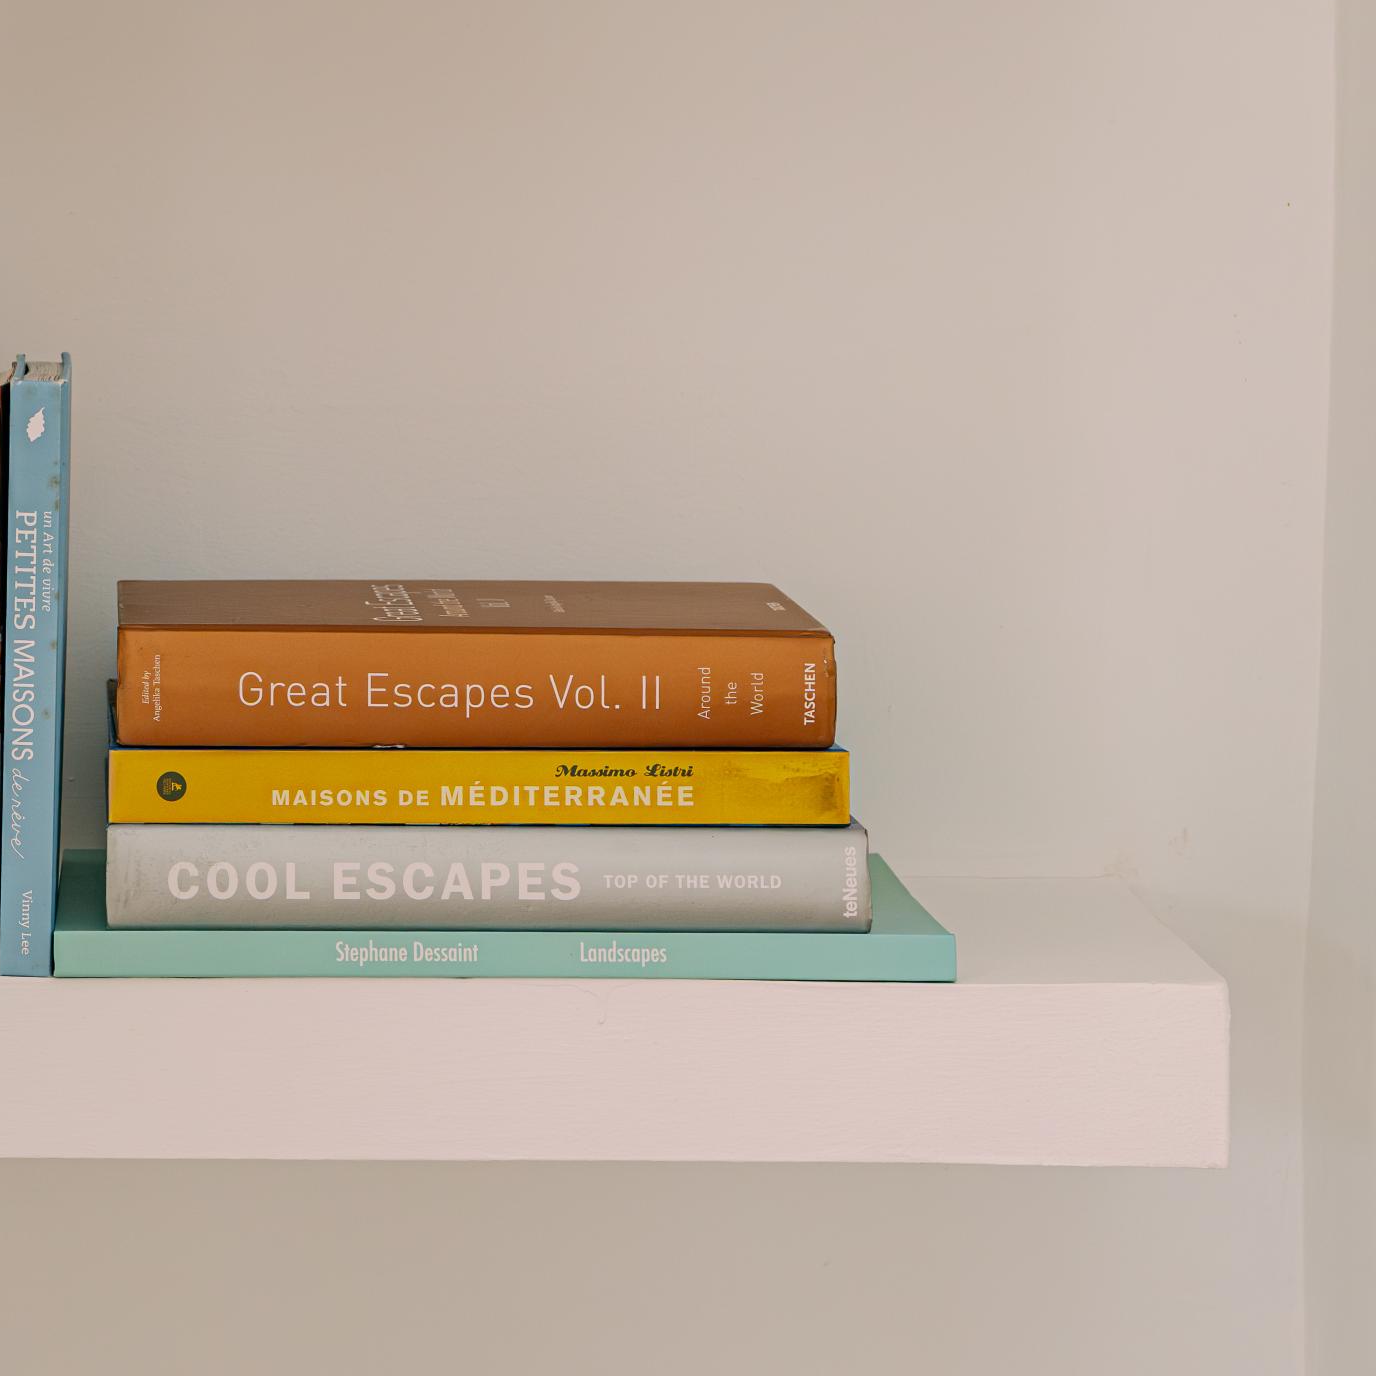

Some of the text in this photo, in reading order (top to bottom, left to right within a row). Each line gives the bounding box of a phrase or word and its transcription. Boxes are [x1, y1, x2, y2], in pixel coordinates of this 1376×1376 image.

[12, 510, 38, 631] PETITES
[42, 511, 56, 613] un Art de vivre
[11, 638, 36, 762] MAISONS
[142, 681, 151, 705] Edited
[152, 654, 162, 722] Angelika Taschen
[238, 671, 662, 719] Great Escapes Vol. II
[697, 666, 765, 720] Around the World
[803, 662, 816, 726] TASCHEN
[271, 780, 695, 807] MAISONS DE MÉDITERRANÉE
[554, 762, 694, 778] Massimo Listri
[167, 861, 582, 901] COOL ESCAPES
[603, 874, 782, 889] TOP OF THE WORLD
[842, 846, 858, 919] teNeues
[20, 889, 33, 956] Vinny Lee
[335, 941, 479, 967] Stephane Dessaint
[579, 940, 667, 967] Landscapes
